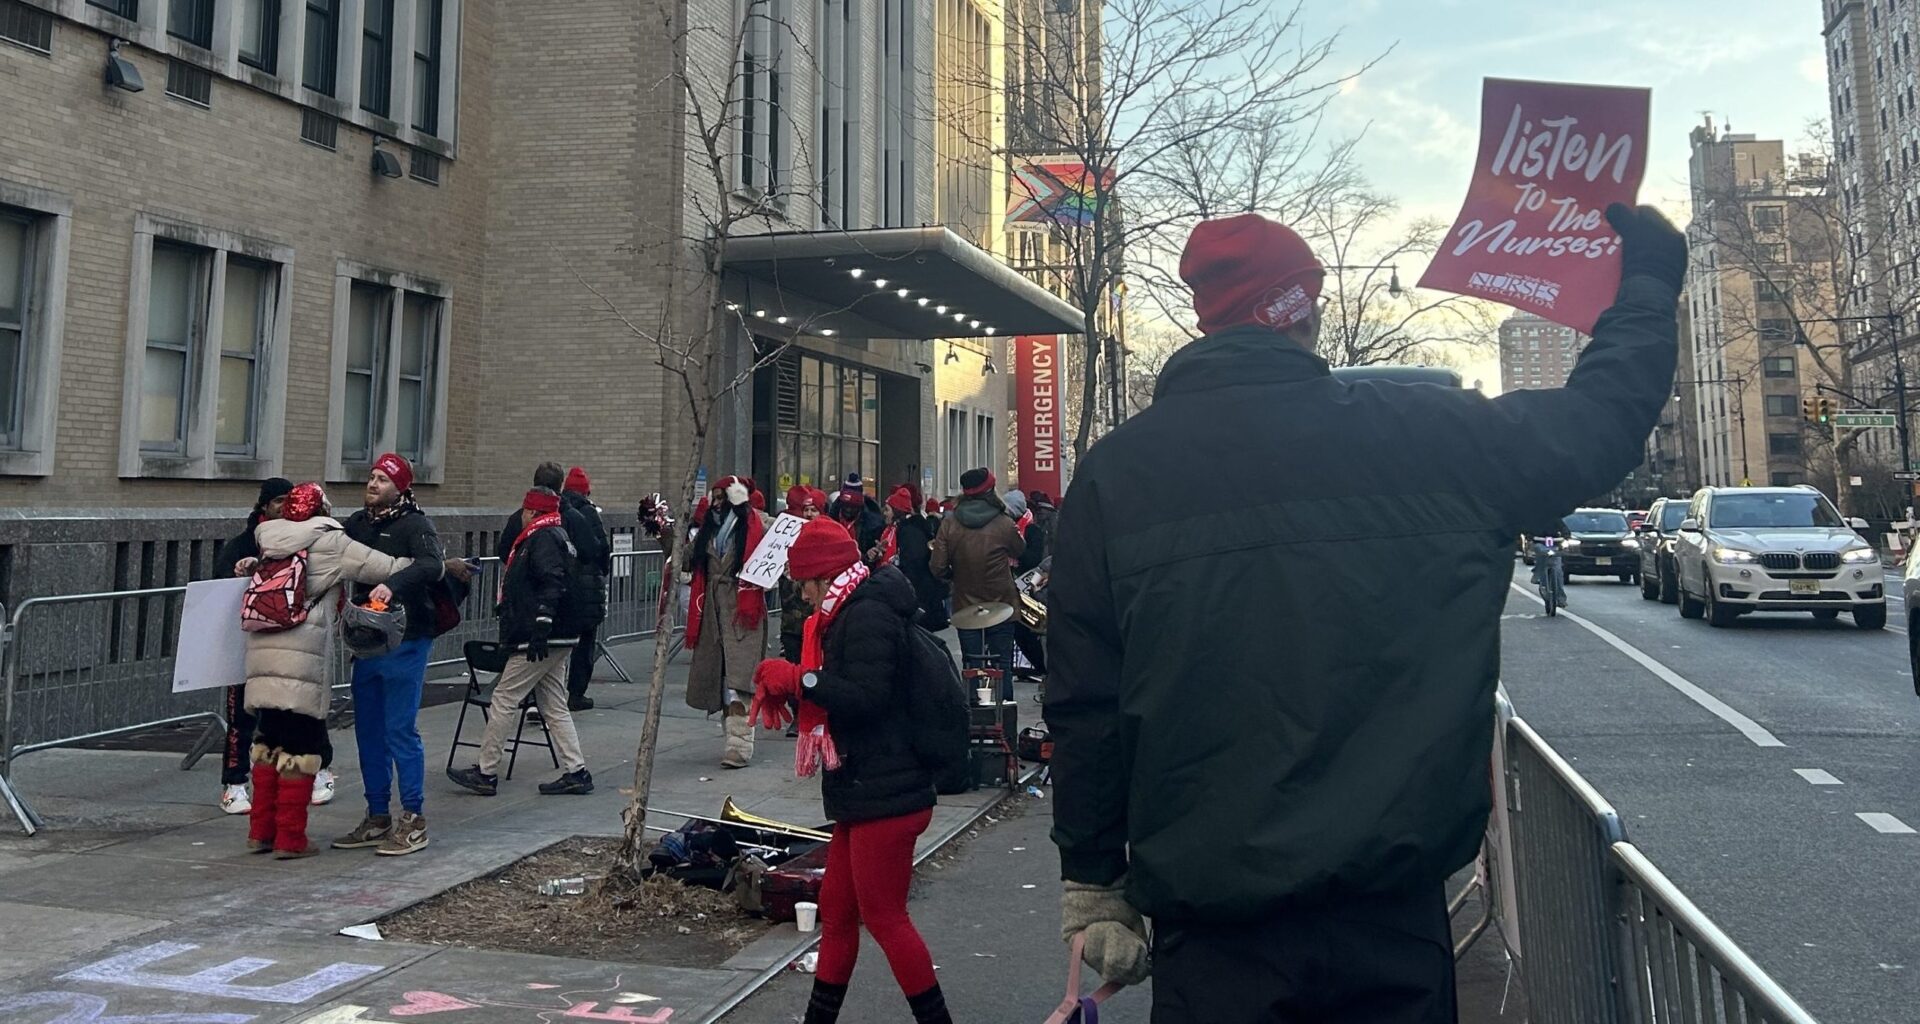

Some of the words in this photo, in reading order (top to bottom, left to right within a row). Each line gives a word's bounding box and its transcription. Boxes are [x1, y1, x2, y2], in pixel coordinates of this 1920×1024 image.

[1466, 283, 1555, 310] ASSOCIATION
[1468, 271, 1560, 302] NURSES
[1032, 340, 1054, 472] EMERGENCY
[1847, 417, 1855, 425] W
[1859, 417, 1870, 425] 113
